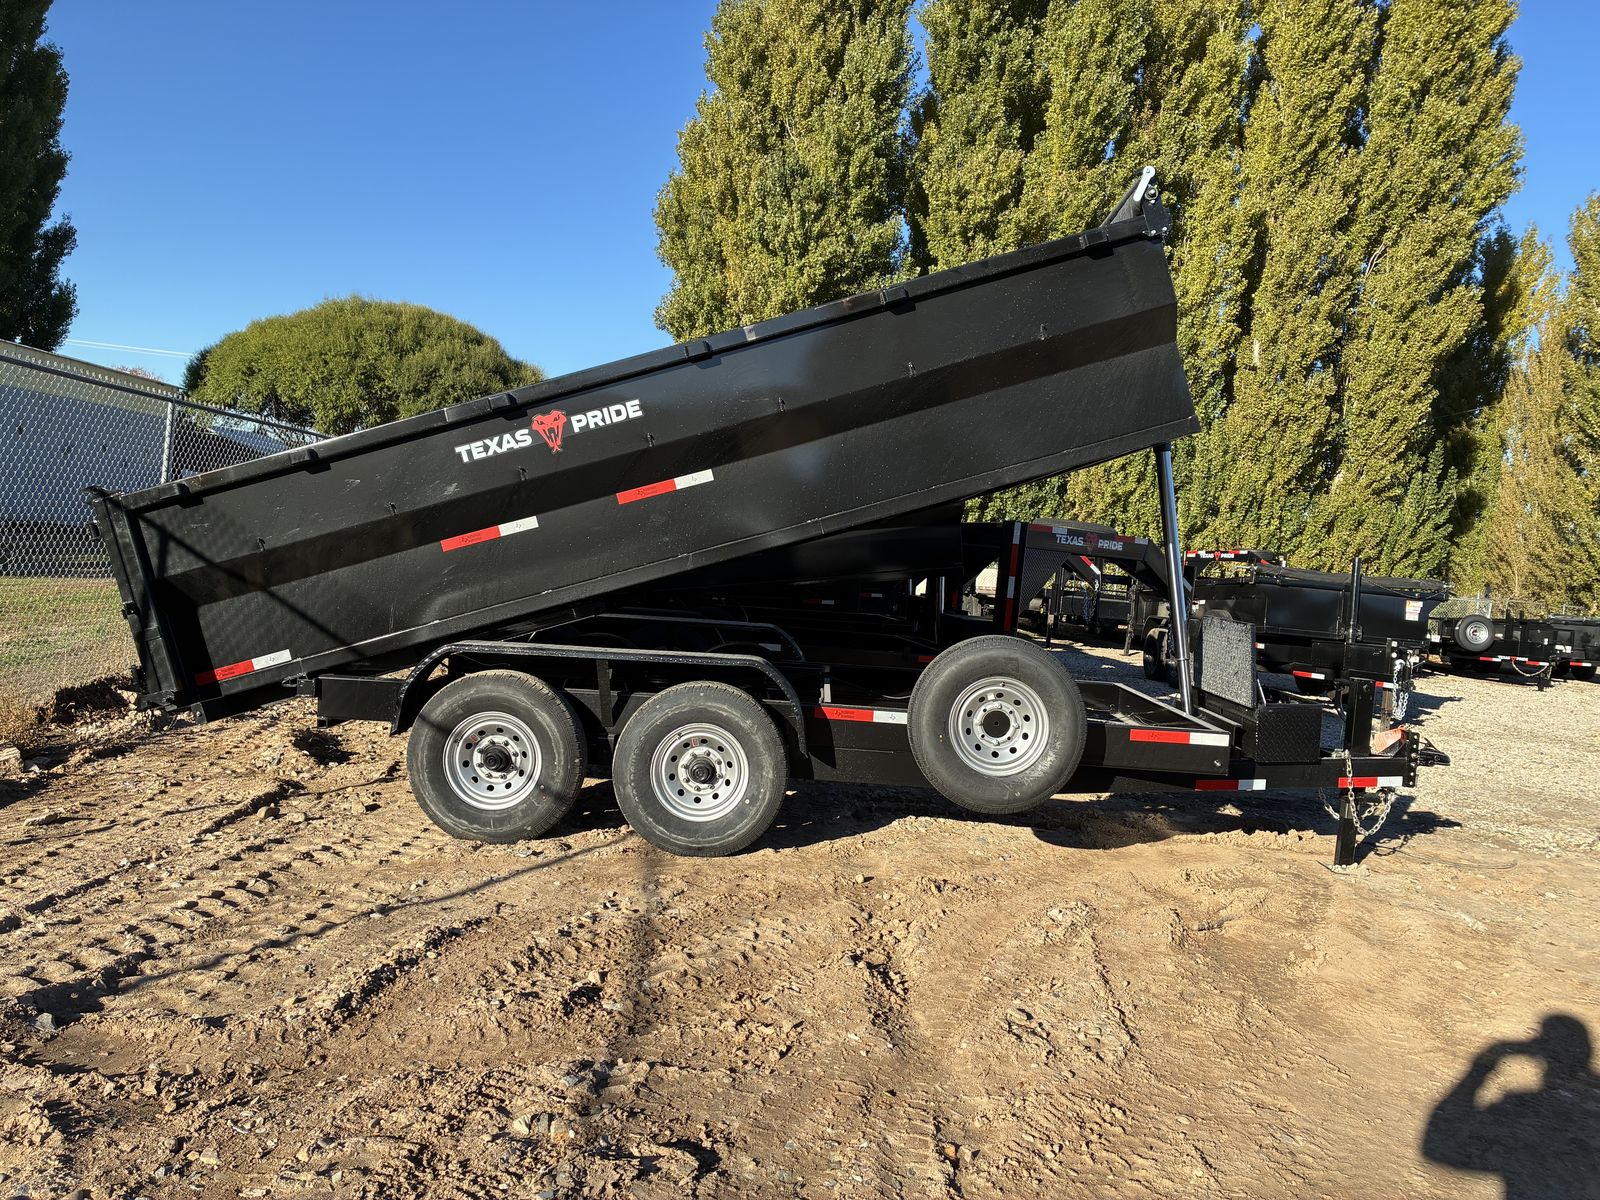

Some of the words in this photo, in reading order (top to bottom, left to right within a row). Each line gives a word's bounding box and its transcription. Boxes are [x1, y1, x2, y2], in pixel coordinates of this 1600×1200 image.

[454, 428, 533, 464] TEXAS
[571, 399, 644, 433] PRIDE
[1056, 534, 1084, 546] TEXAS
[1098, 539, 1124, 551] PRIDE
